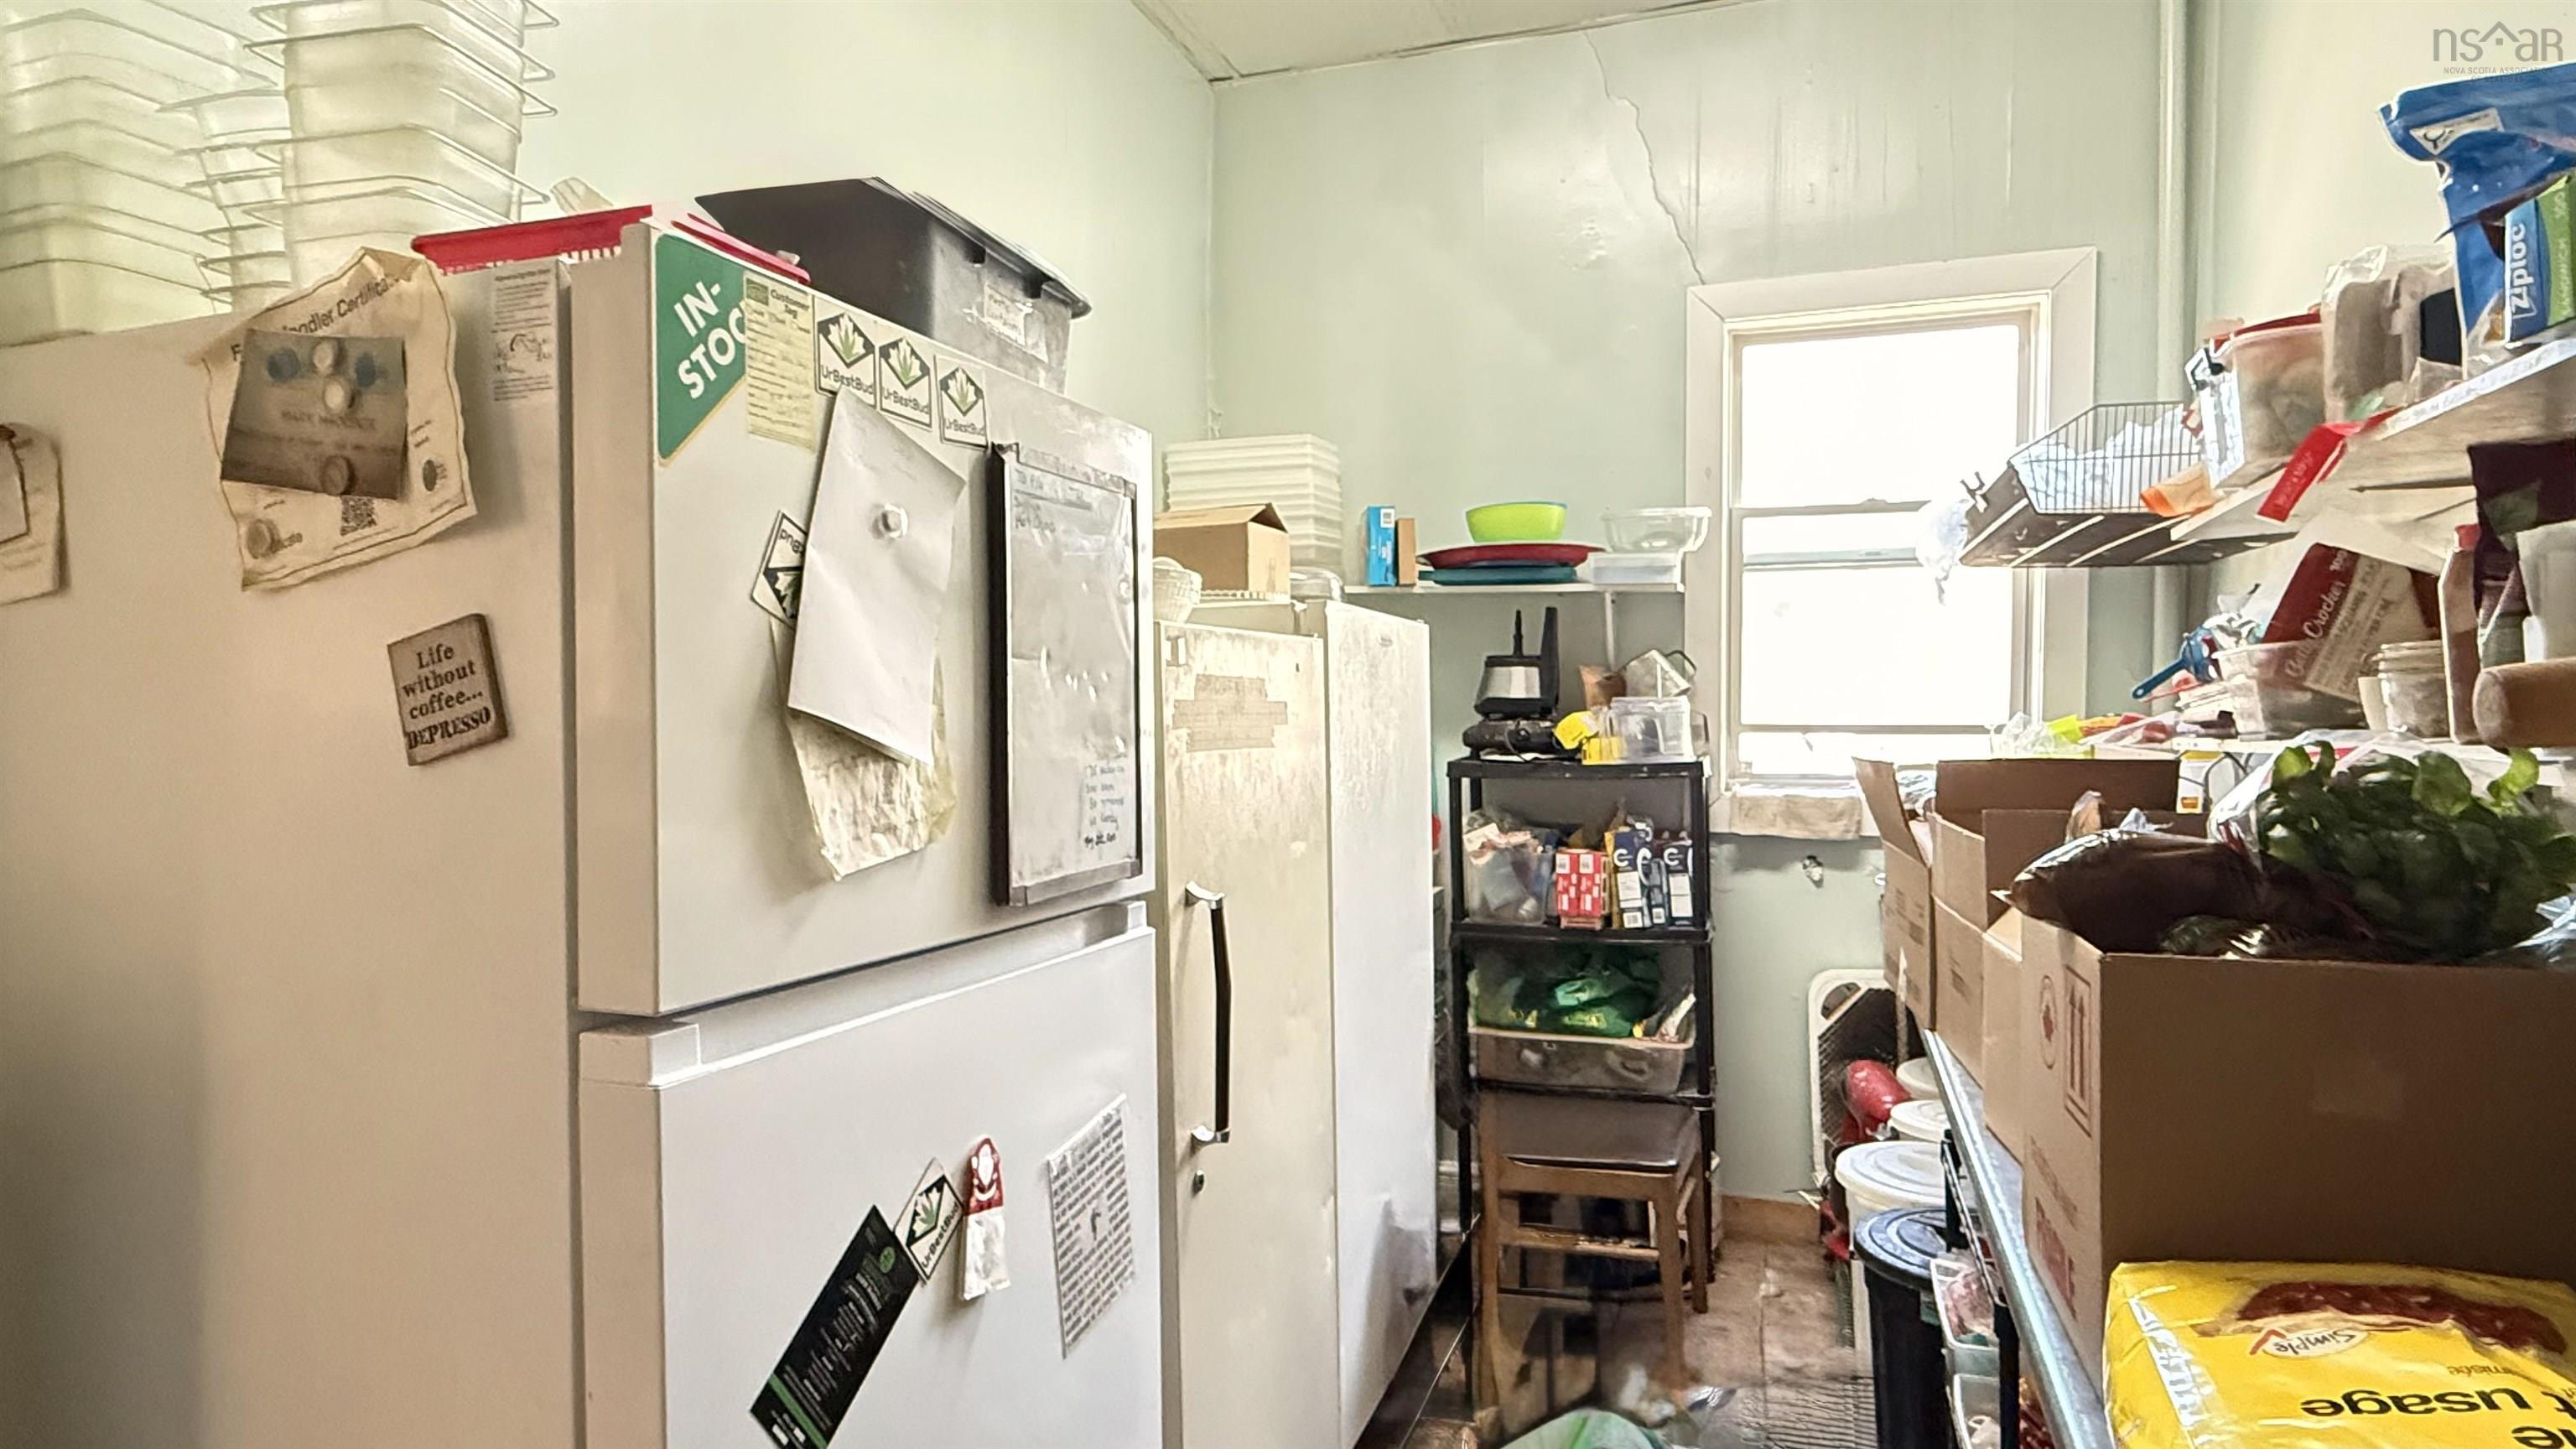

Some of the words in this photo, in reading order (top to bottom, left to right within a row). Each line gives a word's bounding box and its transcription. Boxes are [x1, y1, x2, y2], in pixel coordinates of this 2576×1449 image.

[2511, 223, 2535, 313] Ziploc
[674, 281, 721, 338] IN-
[678, 307, 745, 400] STOC
[820, 365, 874, 396] UrBestBud
[882, 387, 930, 415] UrBestBud
[945, 419, 986, 436] UrBestBud
[2303, 581, 2346, 638] Crocker
[416, 643, 454, 669] Life
[402, 660, 476, 698] without
[409, 690, 483, 719] coffee...
[406, 706, 491, 750] DEPRESSO
[922, 1202, 960, 1269] UrBestBud
[2273, 1328, 2356, 1357] Simple
[2300, 1387, 2532, 1417] usage
